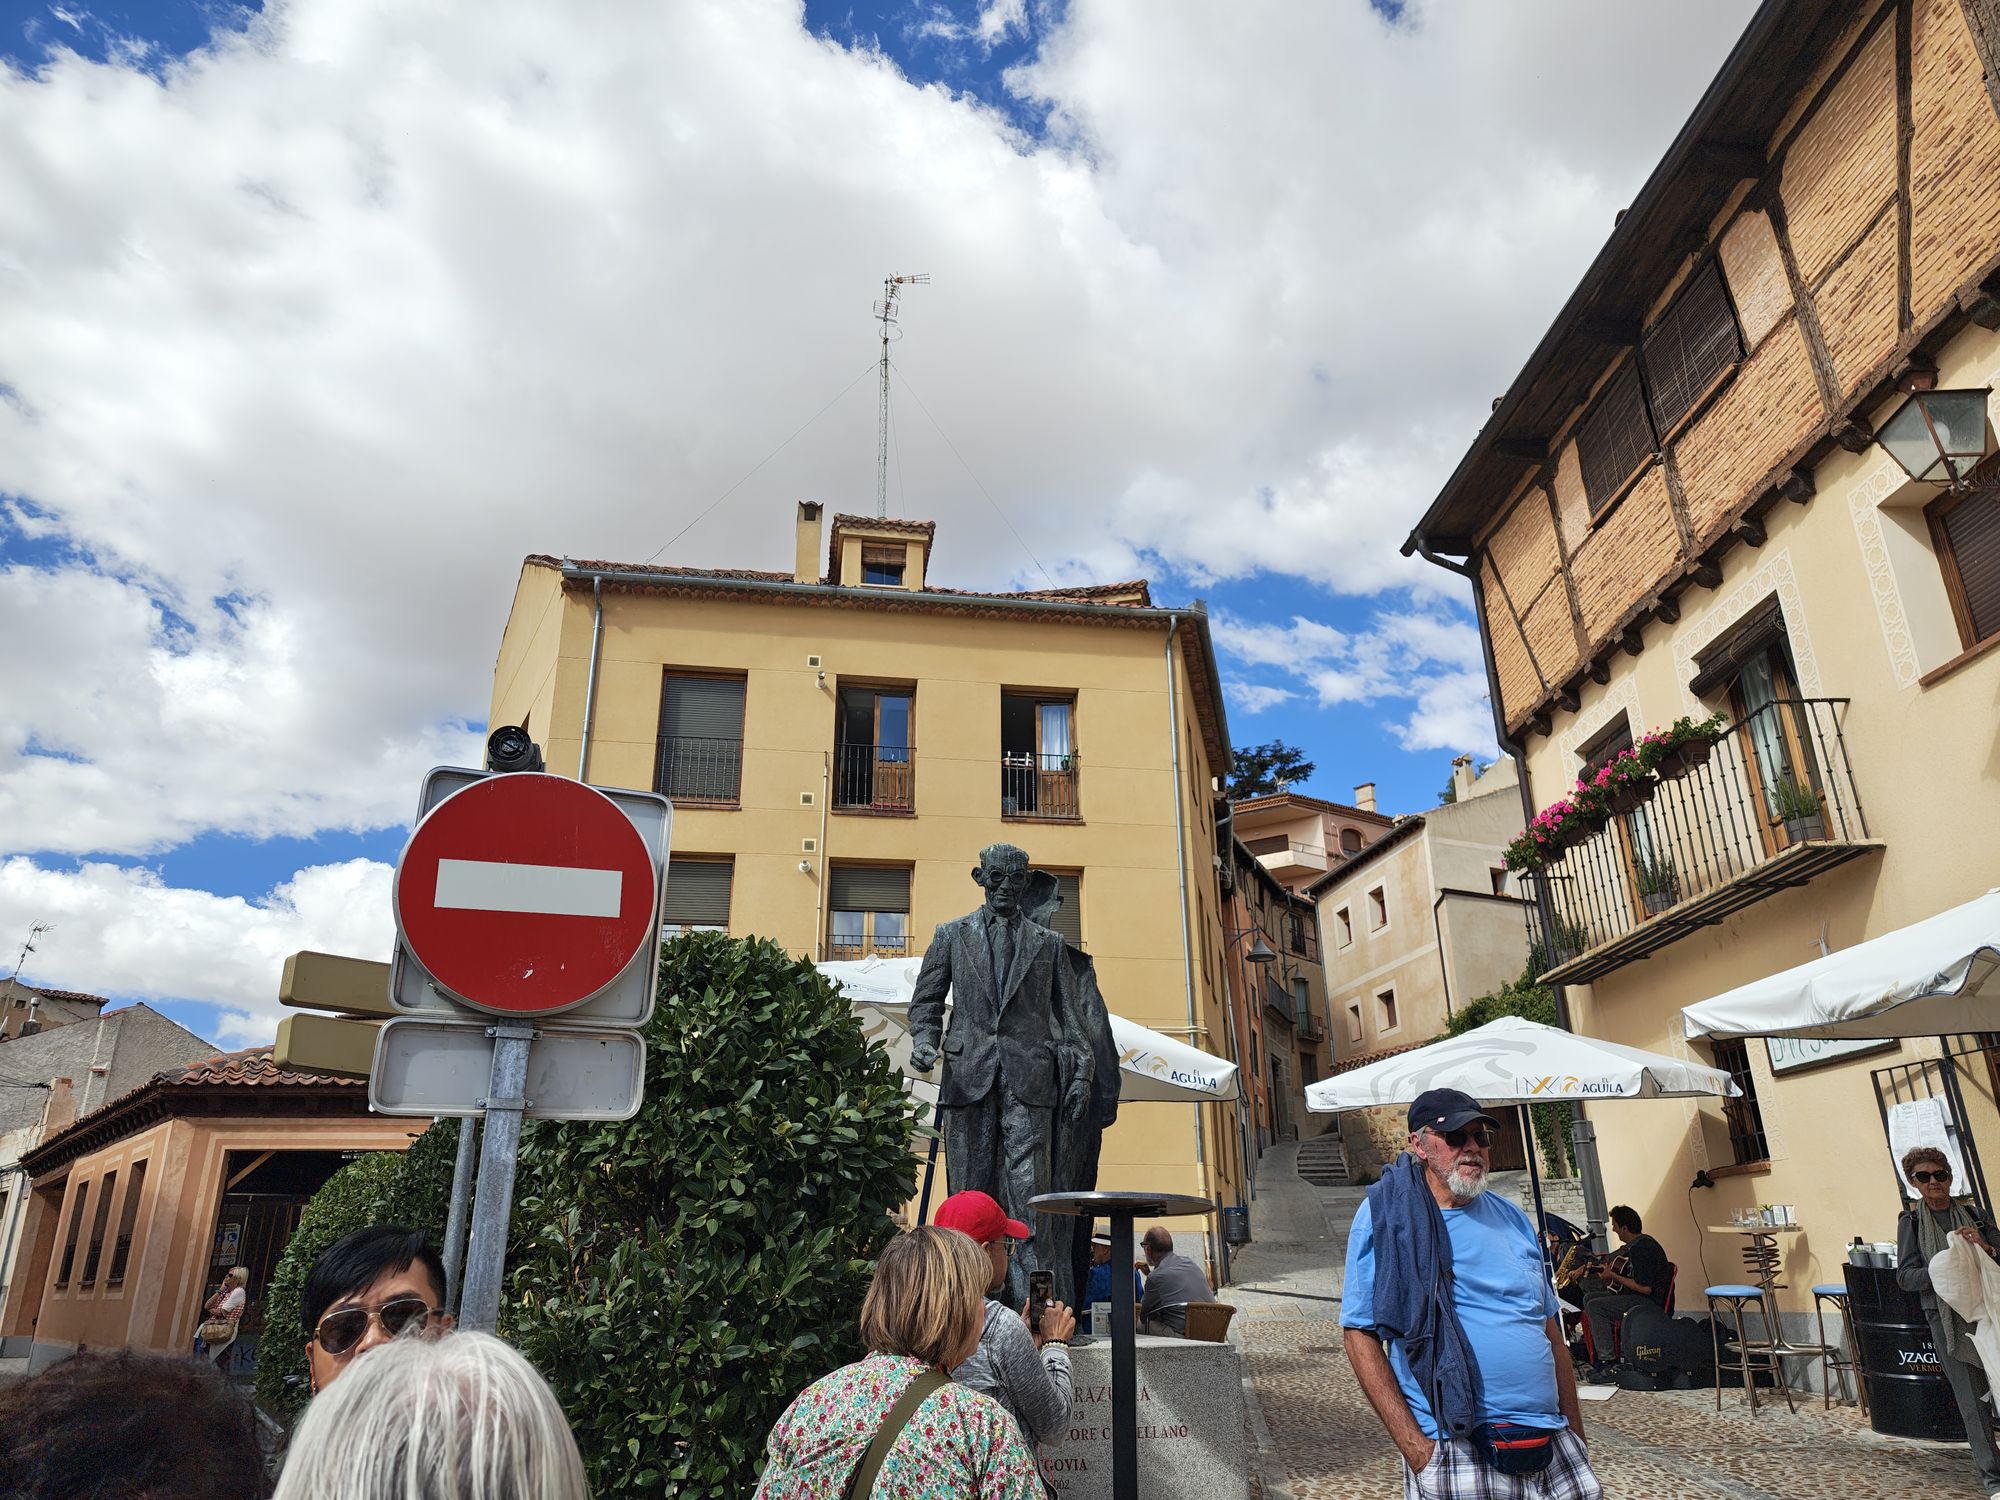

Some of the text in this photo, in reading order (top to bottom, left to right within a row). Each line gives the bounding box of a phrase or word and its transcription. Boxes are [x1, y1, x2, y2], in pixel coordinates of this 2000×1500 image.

[1636, 1345, 1661, 1360] Gibson
[1922, 1342, 1937, 1350] 18
[1040, 1458, 1088, 1473] GOVIA
